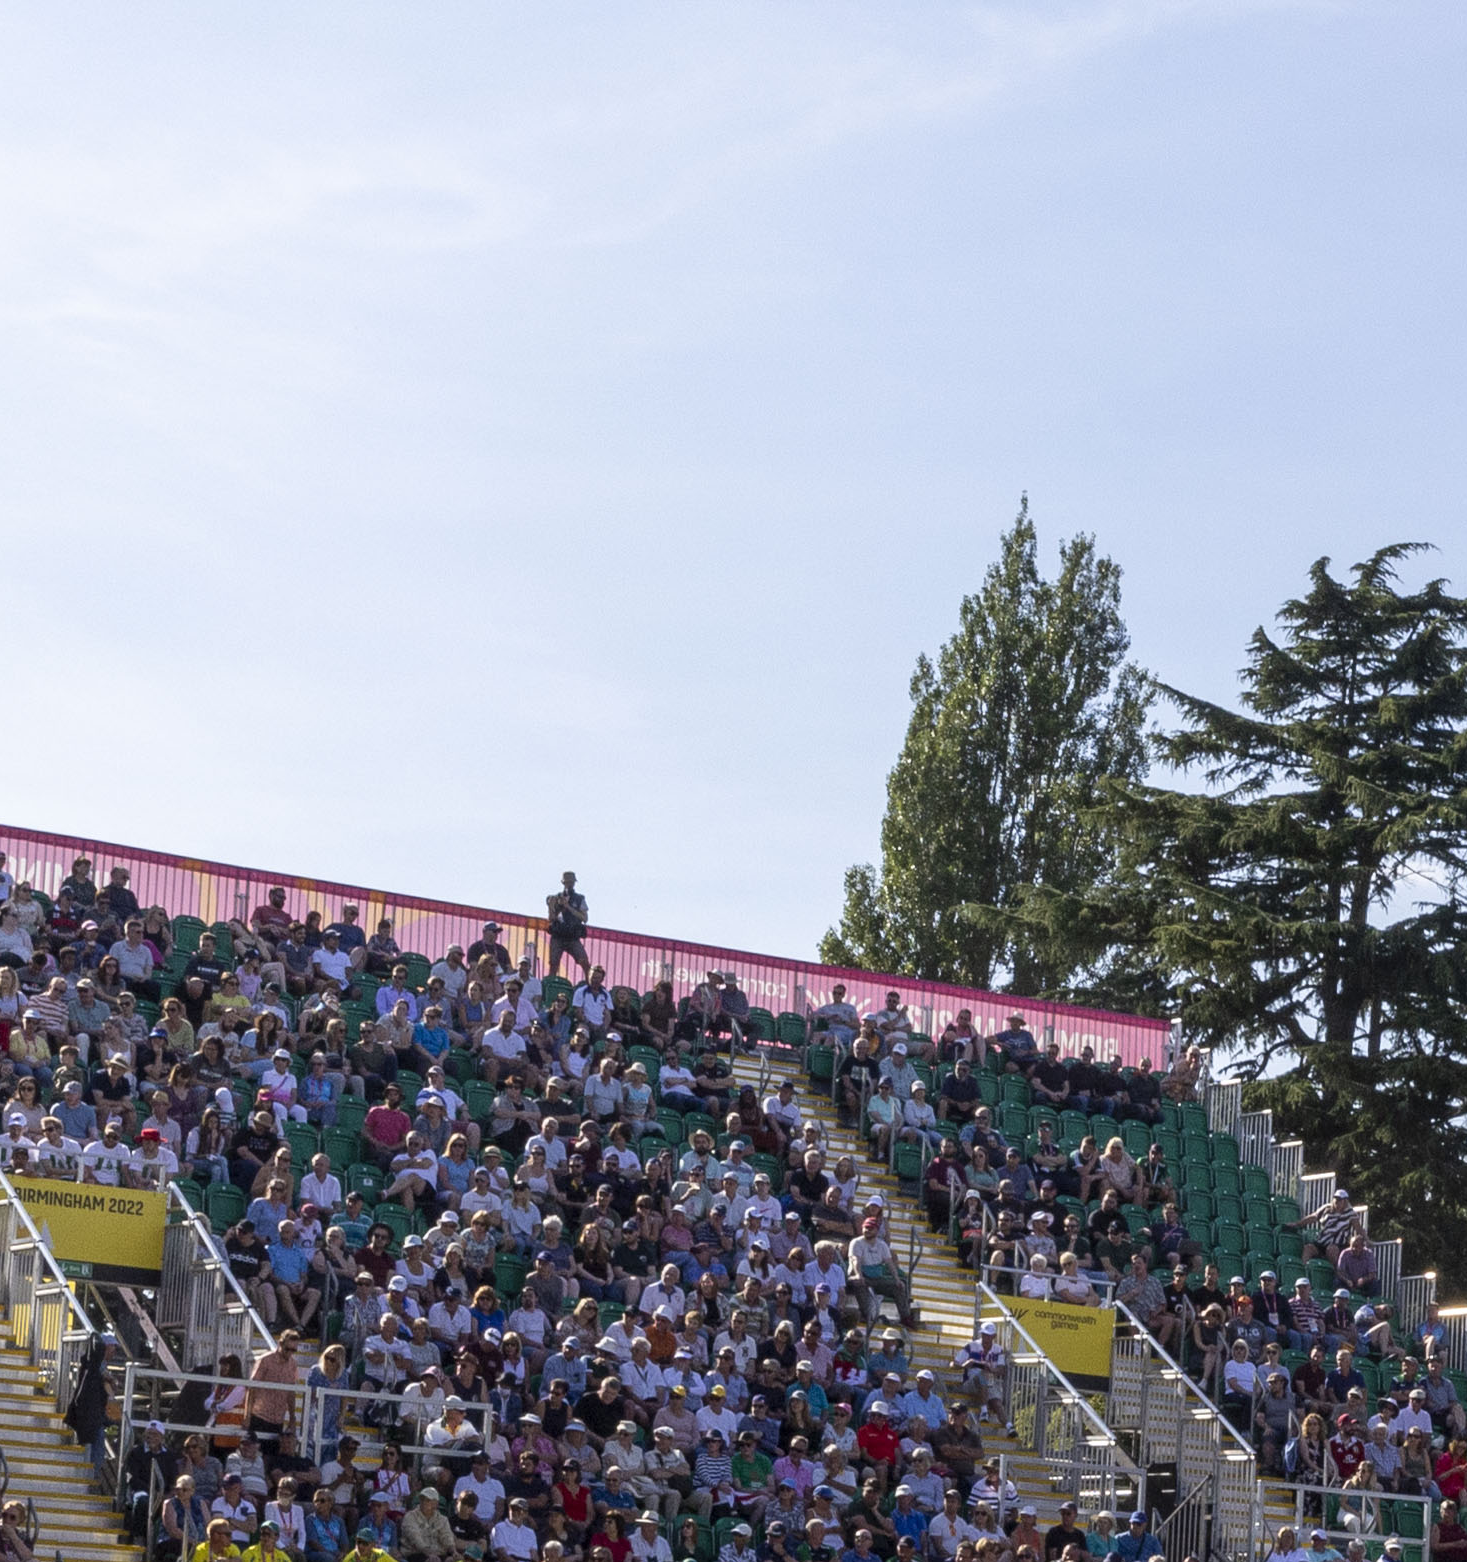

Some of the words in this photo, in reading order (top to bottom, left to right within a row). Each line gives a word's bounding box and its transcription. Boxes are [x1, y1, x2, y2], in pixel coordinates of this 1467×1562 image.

[14, 1187, 104, 1212] BIRMINGHAM
[108, 1198, 144, 1216] 2022
[1034, 1310, 1097, 1325] commonwealth
[1050, 1320, 1079, 1331] games
